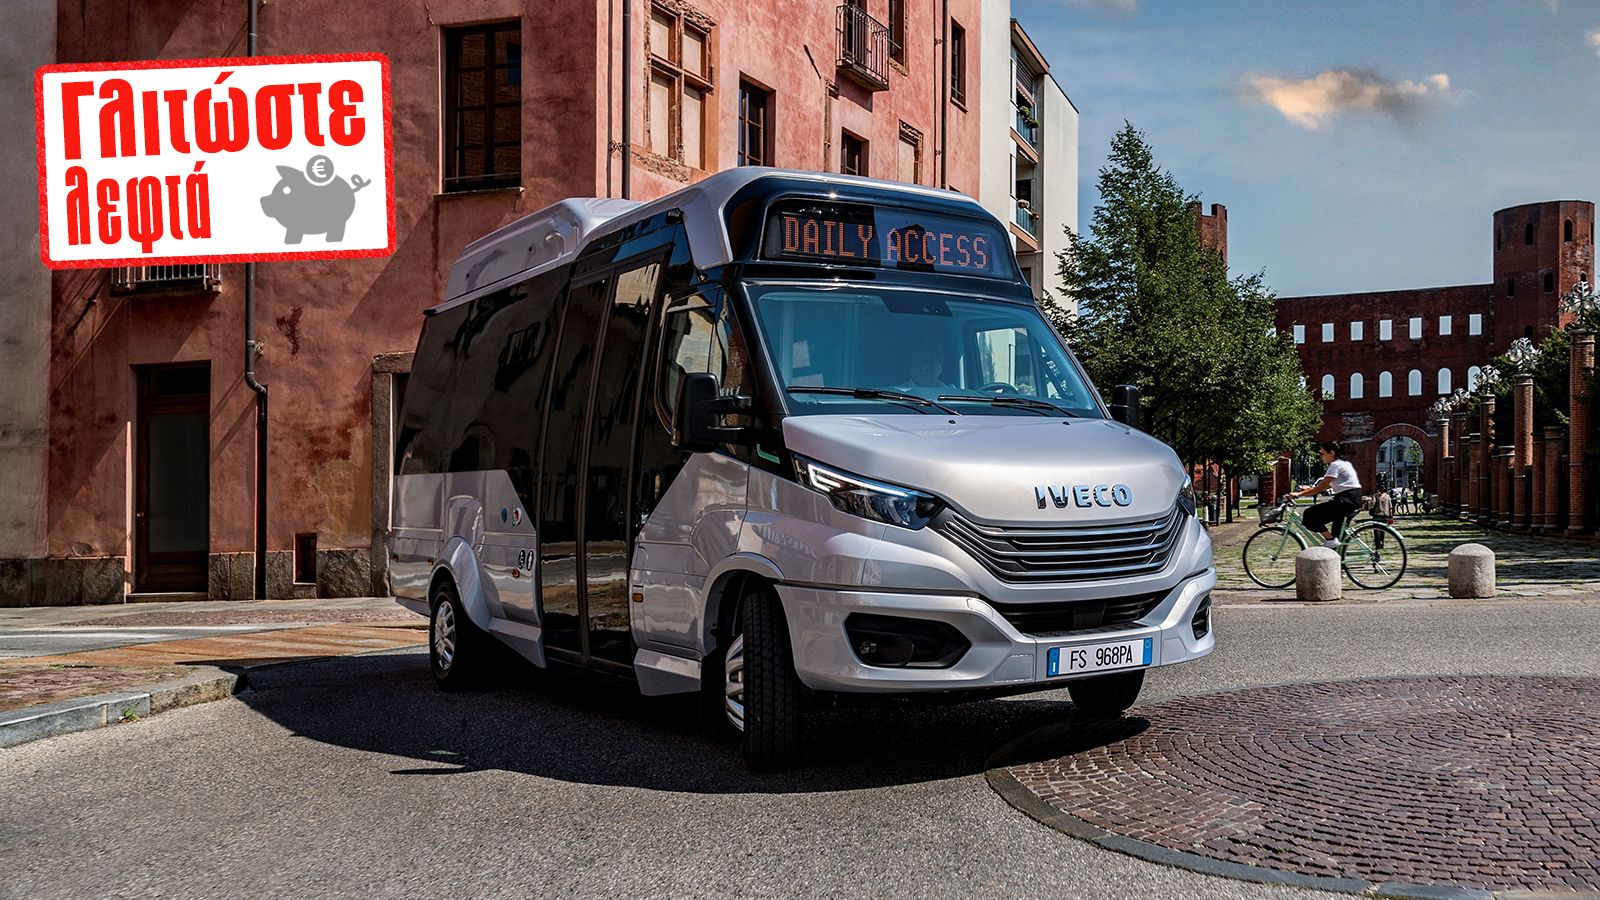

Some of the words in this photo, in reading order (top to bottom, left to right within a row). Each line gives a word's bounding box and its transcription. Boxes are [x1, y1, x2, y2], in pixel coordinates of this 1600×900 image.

[783, 215, 874, 259] DAILY
[886, 227, 988, 270] ACCESS
[1034, 483, 1133, 510] IVECO
[1070, 649, 1087, 670] FS
[1096, 645, 1133, 667] 968PA
